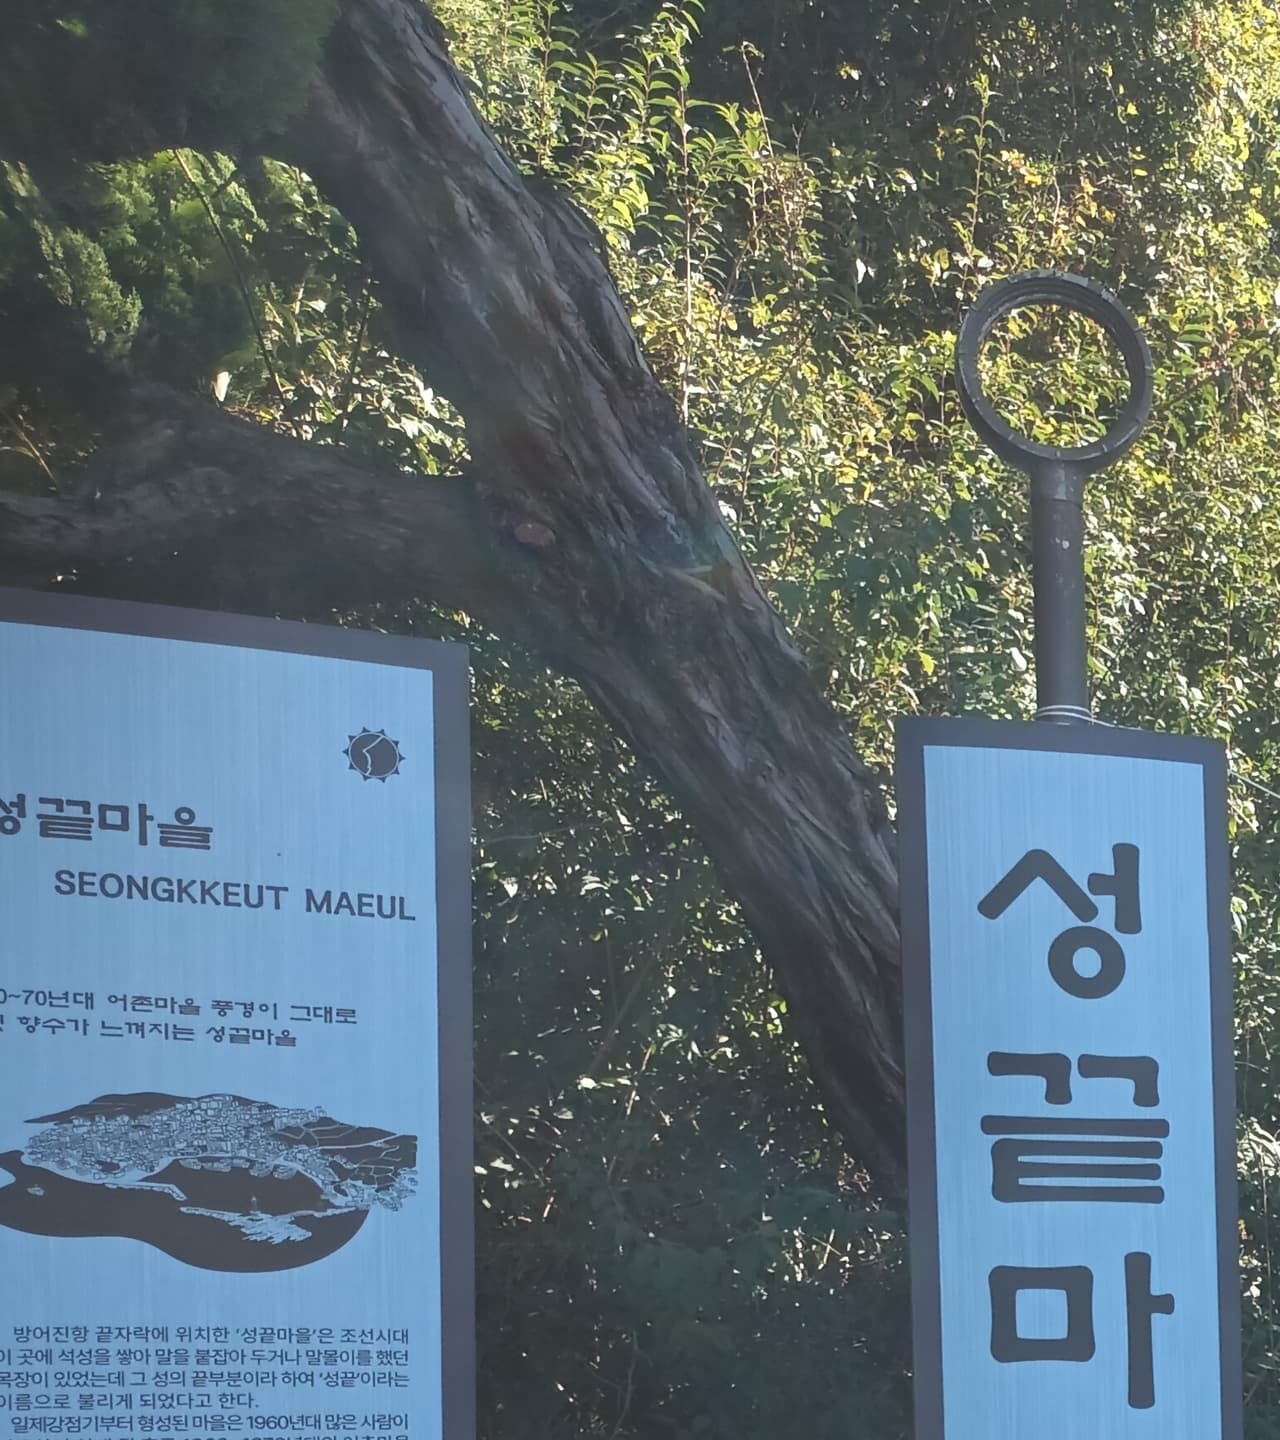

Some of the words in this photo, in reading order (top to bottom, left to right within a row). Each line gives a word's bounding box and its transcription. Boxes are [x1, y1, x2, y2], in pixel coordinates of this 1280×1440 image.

[0, 793, 214, 851] 성끝마을
[54, 869, 289, 910] SEONGKKEUT
[305, 888, 416, 921] MAEUL
[211, 999, 278, 1021] 풍경이
[290, 1004, 357, 1025] 그대로
[17, 1016, 90, 1037] 향수가
[205, 1026, 297, 1047] 성끝마을
[14, 1326, 90, 1344] 방어진항
[95, 1326, 169, 1344] 끝자락에
[176, 1326, 231, 1344] 위치한
[340, 1328, 409, 1345] 조선시대
[17, 1349, 53, 1366] 곳에
[58, 1348, 112, 1366] 석성을
[155, 1348, 191, 1366] 말을
[249, 1349, 303, 1367] 두거나
[376, 1350, 409, 1367] 했던
[54, 1371, 126, 1388] 있었는데
[130, 1372, 148, 1386] 그
[152, 1371, 186, 1388] 성의
[192, 1371, 279, 1388] 끝부분이라
[281, 1371, 315, 1388] 하여
[78, 1393, 133, 1411] 불리게
[140, 1393, 213, 1410] 되었다고
[218, 1392, 260, 1410] 한다.
[11, 1416, 134, 1434] 일제강점기부터
[137, 1415, 189, 1433] 형성된
[192, 1414, 244, 1432] 마을은
[246, 1414, 322, 1431] 1960년대
[325, 1414, 358, 1431] 많은
[361, 1414, 409, 1431] 사람이
